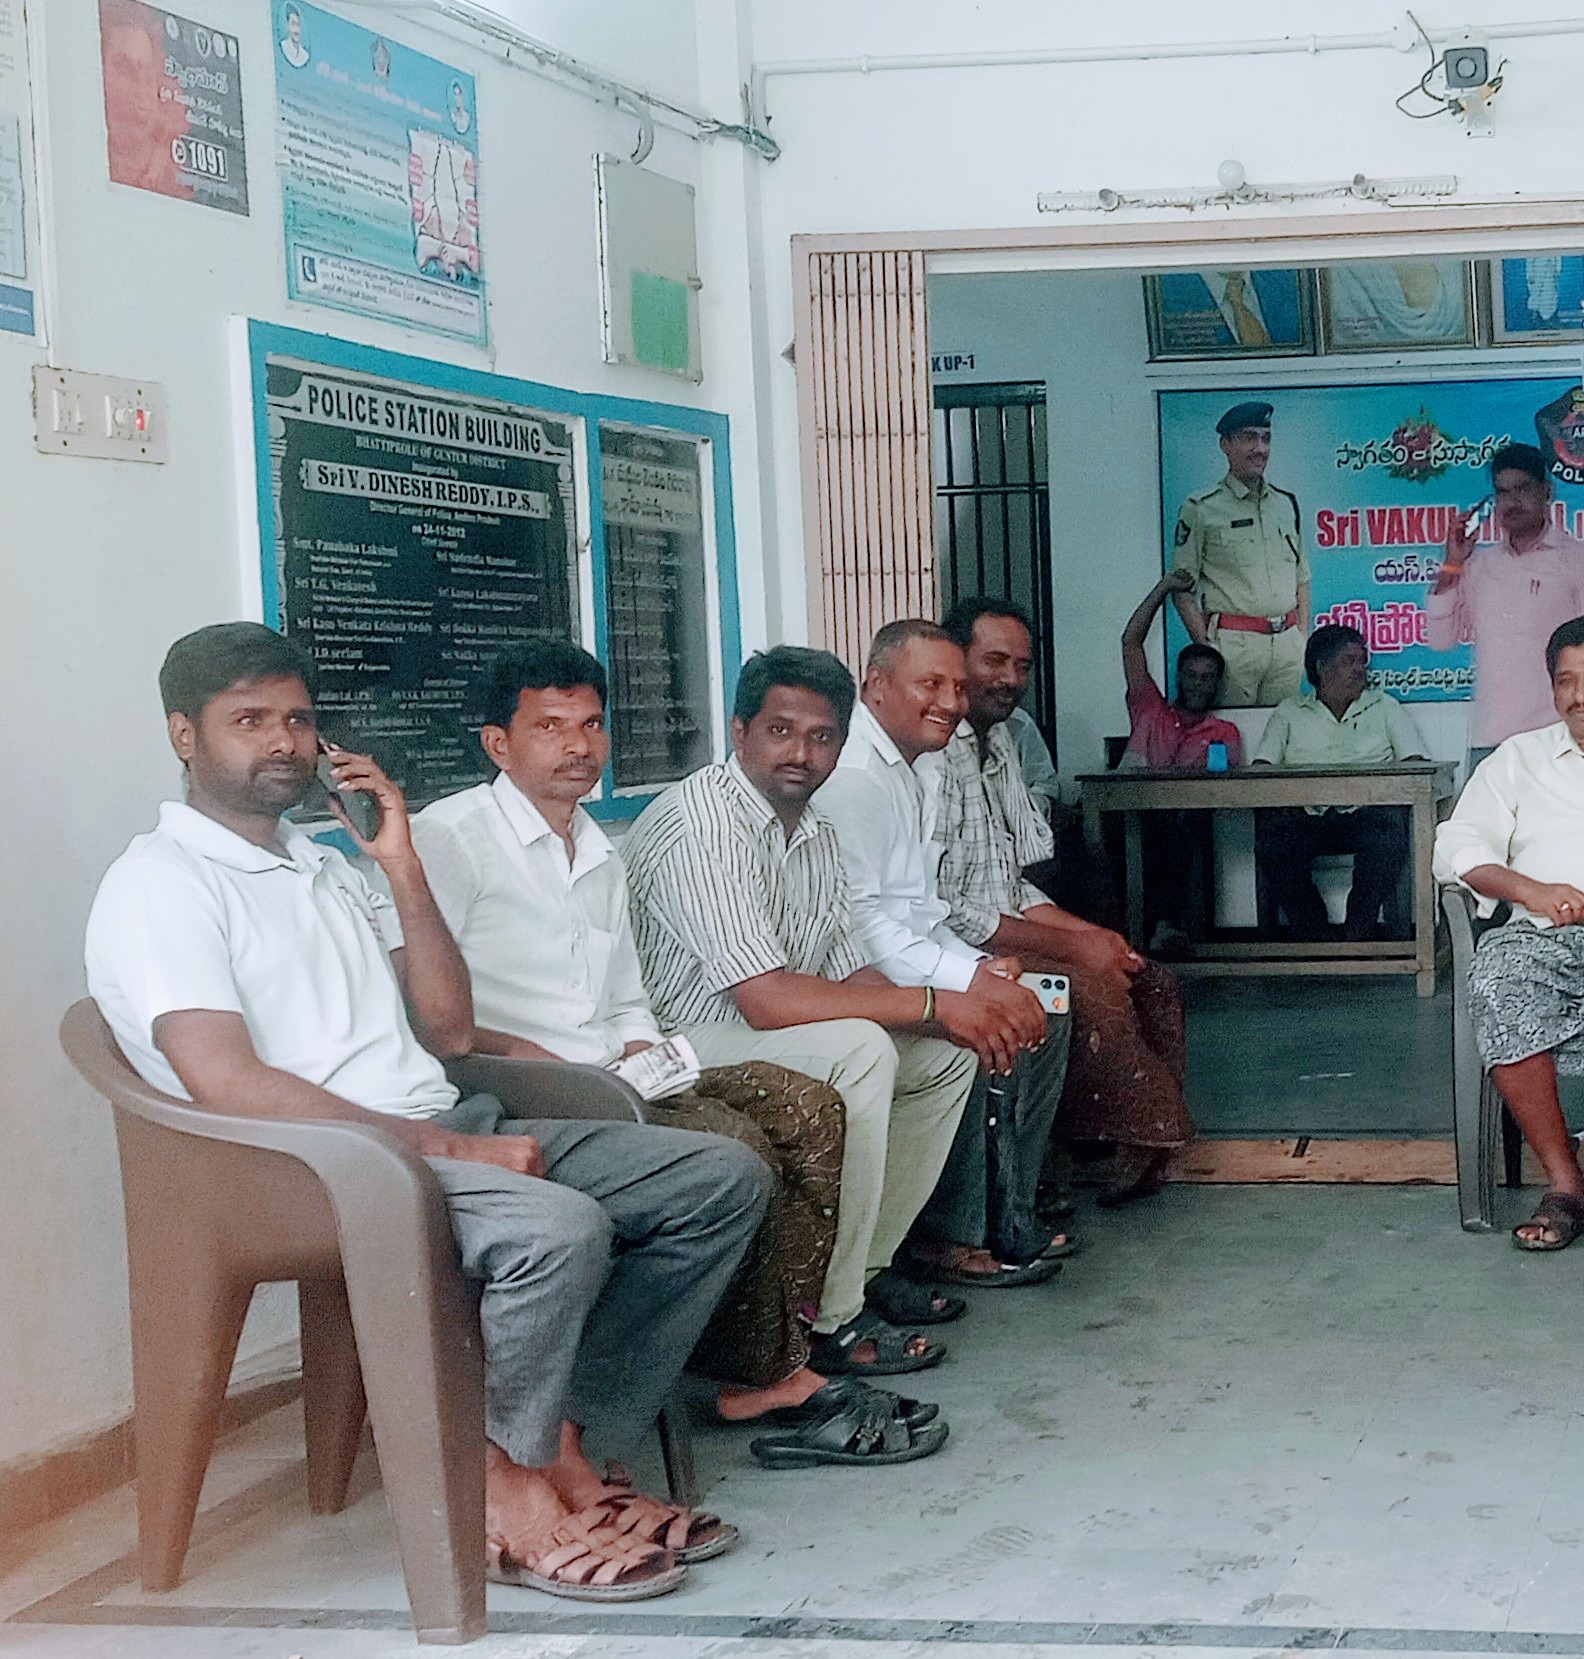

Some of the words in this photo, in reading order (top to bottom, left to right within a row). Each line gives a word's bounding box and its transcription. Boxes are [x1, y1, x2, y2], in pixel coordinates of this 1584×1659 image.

[190, 142, 225, 176] 1091
[944, 354, 975, 370] UP-1
[309, 384, 379, 426] POLICE
[385, 400, 460, 441] STATION
[466, 415, 541, 453] BUILDING
[1336, 438, 1409, 472] స్వాగతం
[1431, 435, 1510, 468] సుస్వాగ
[369, 472, 433, 500] DINESH
[1317, 509, 1361, 547] Sri
